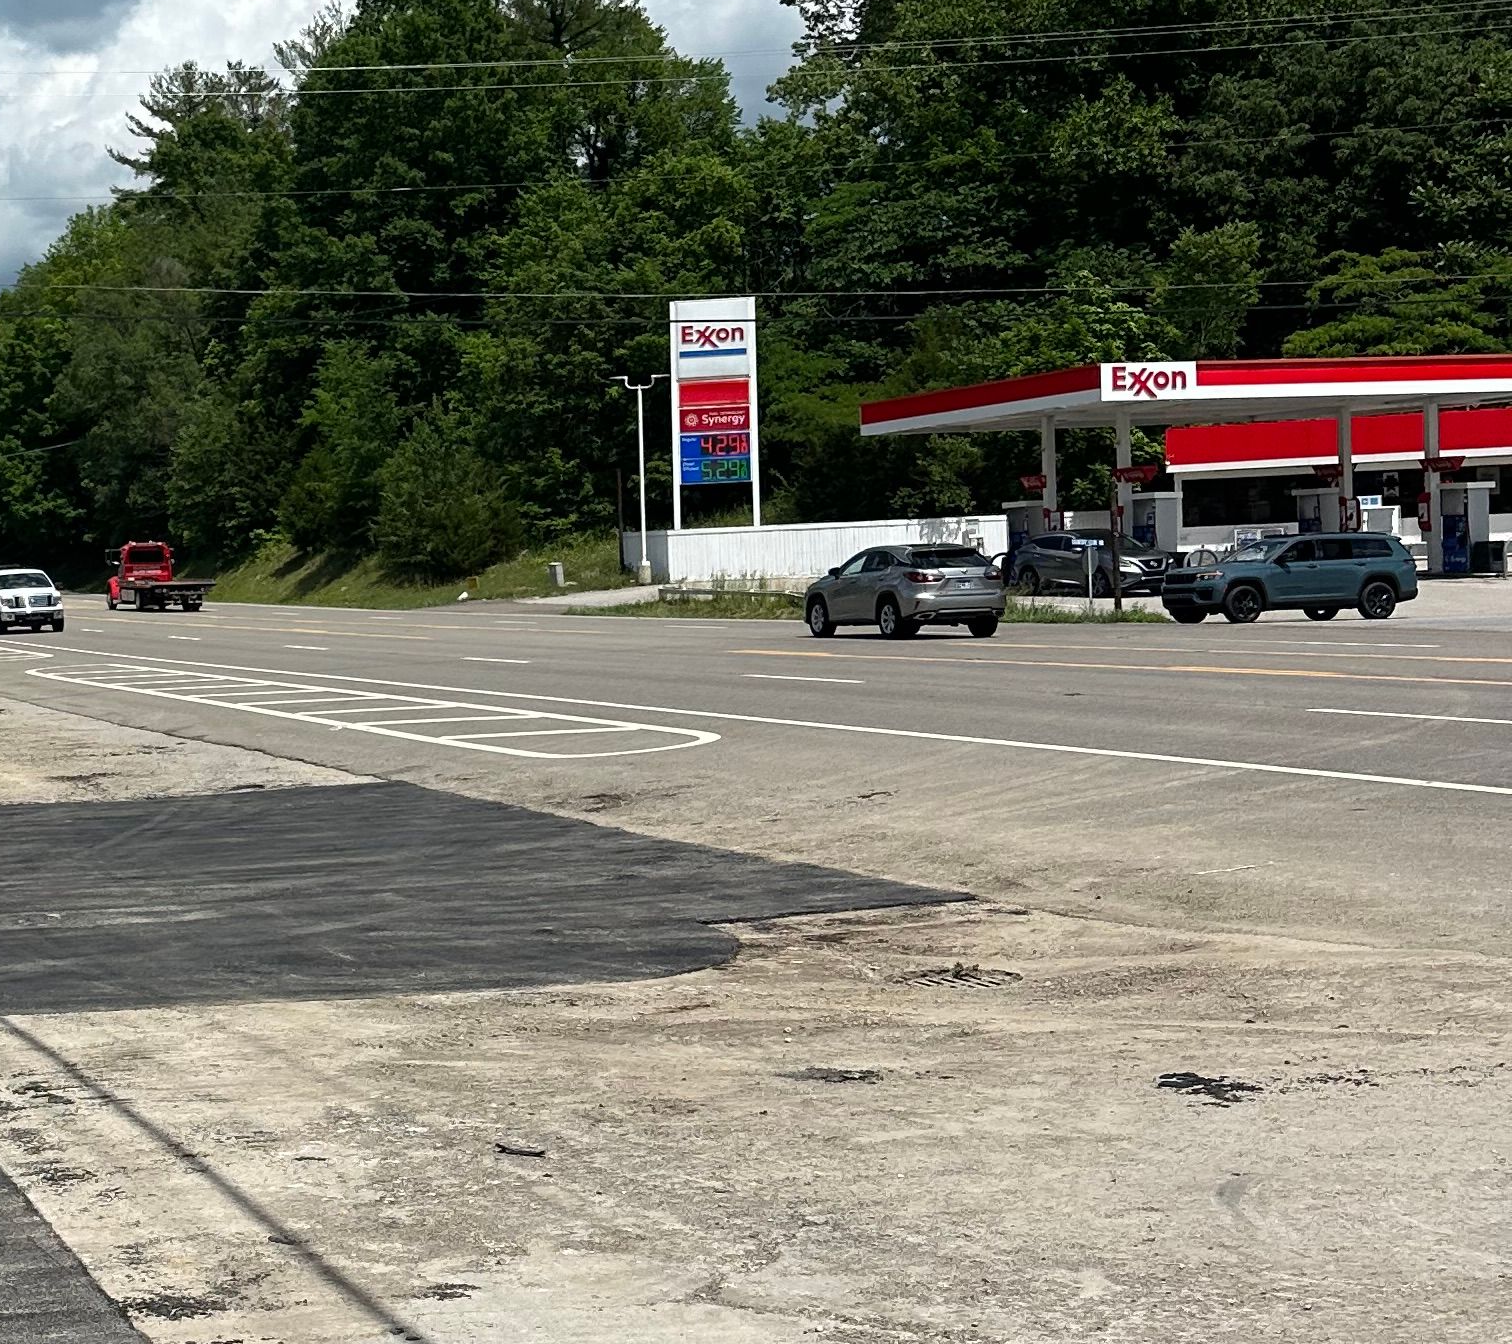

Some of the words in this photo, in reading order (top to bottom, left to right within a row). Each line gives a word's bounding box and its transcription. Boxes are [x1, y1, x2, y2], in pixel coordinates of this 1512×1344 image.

[681, 325, 744, 348] Exxon
[1111, 366, 1187, 399] Exxon
[701, 414, 745, 427] Synergy
